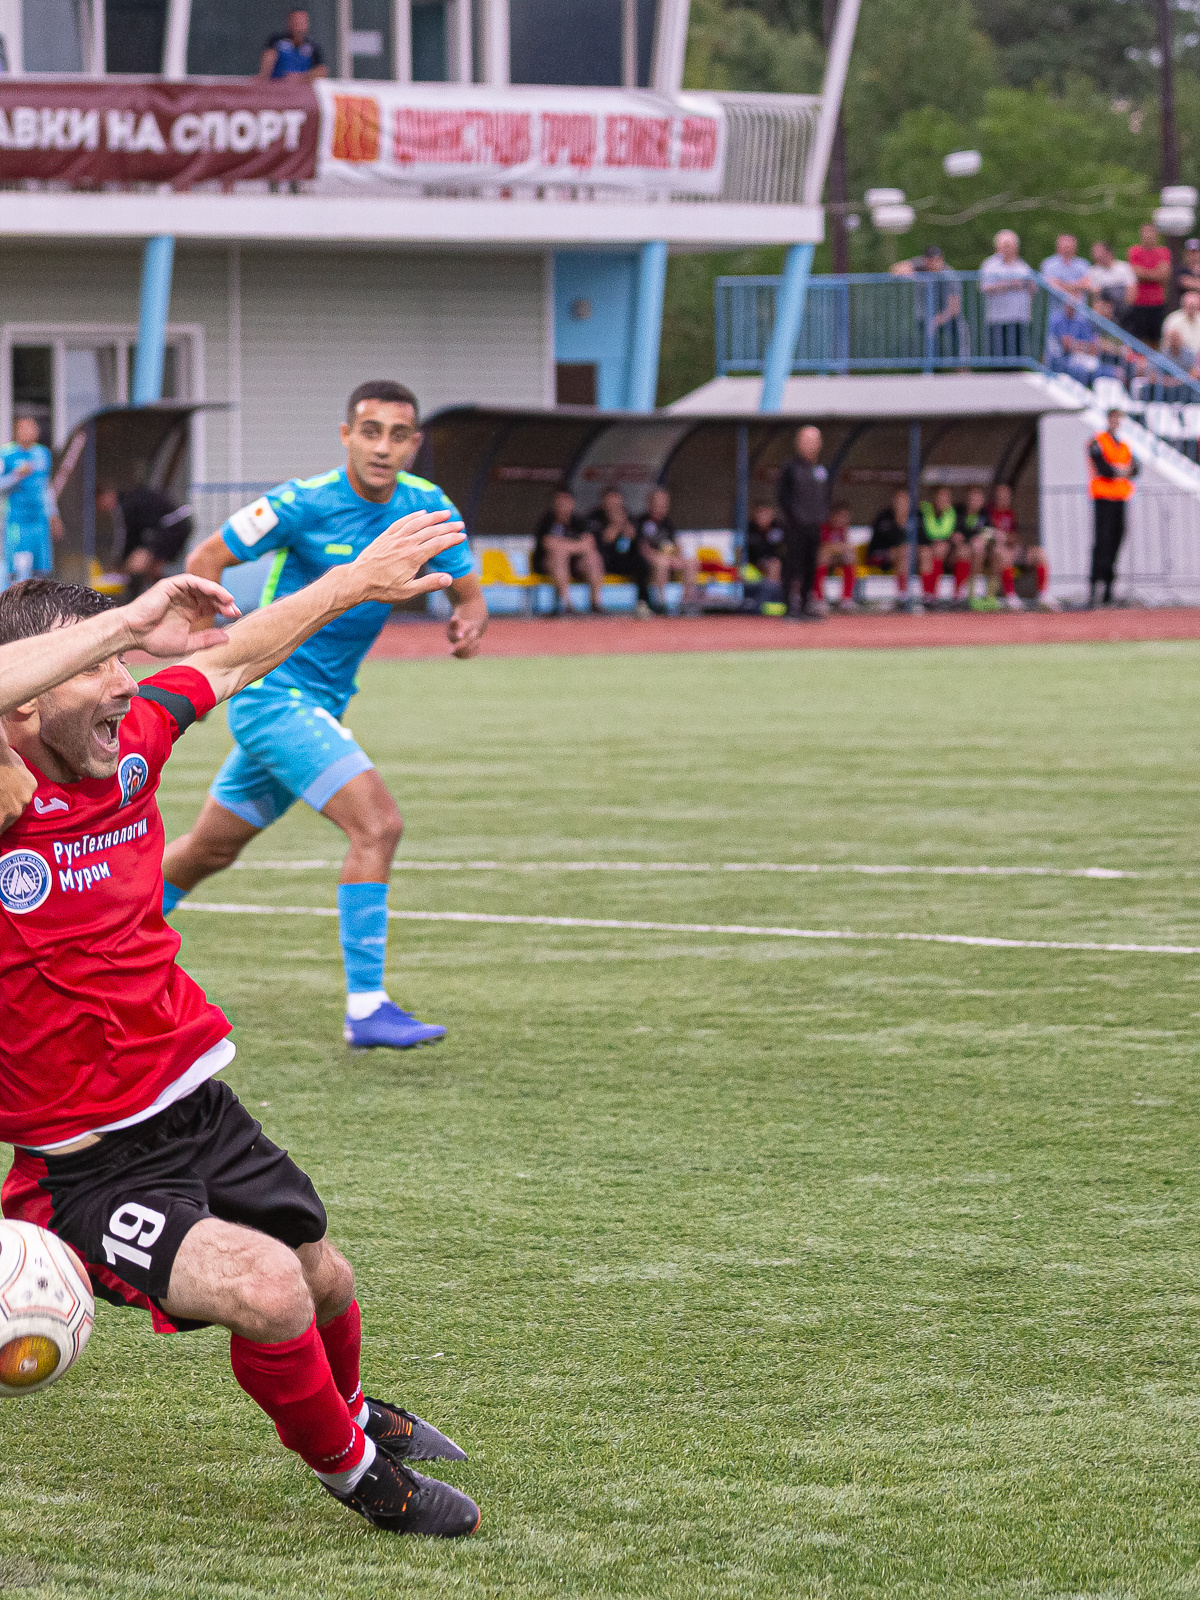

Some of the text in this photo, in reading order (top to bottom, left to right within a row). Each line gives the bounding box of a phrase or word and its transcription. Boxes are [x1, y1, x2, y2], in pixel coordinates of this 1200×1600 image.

[105, 108, 168, 155] НА
[170, 109, 307, 155] СПОРТ
[52, 817, 148, 866] РусТехнологии
[57, 861, 112, 893] Муром
[102, 1202, 166, 1271] 19
